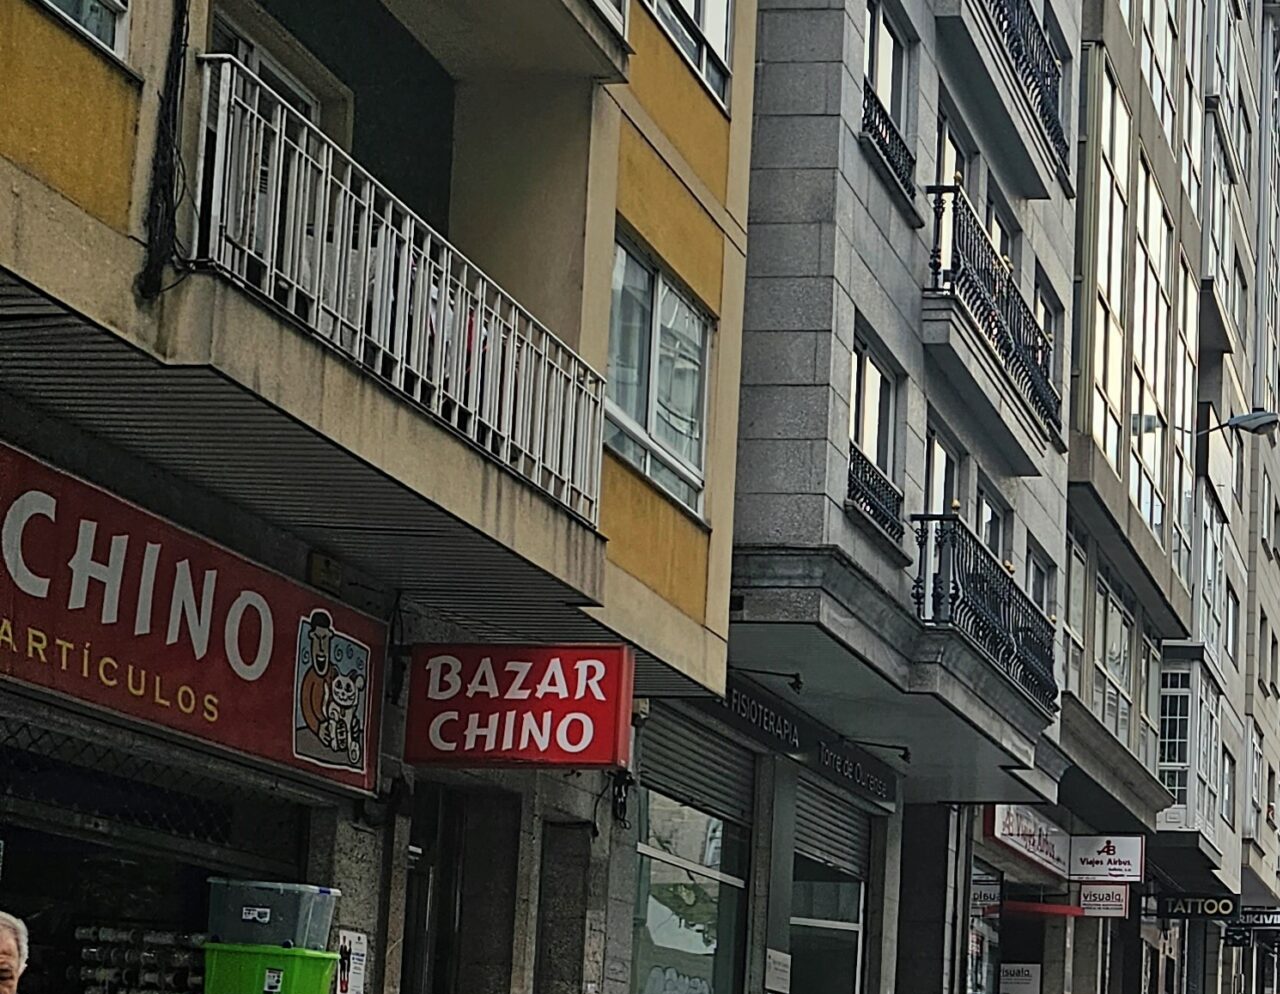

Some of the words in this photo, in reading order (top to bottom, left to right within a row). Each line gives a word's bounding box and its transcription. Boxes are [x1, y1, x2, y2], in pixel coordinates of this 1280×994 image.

[1, 489, 274, 682] CHINO
[0, 618, 219, 722] ARTÍCULOS
[425, 655, 607, 701] BAZAR
[427, 710, 595, 753] CHINO
[731, 688, 800, 748] FISIOTERAPIA
[819, 740, 842, 773] Torre
[1080, 857, 1104, 867] Viajes
[1167, 899, 1234, 915] TATTOO
